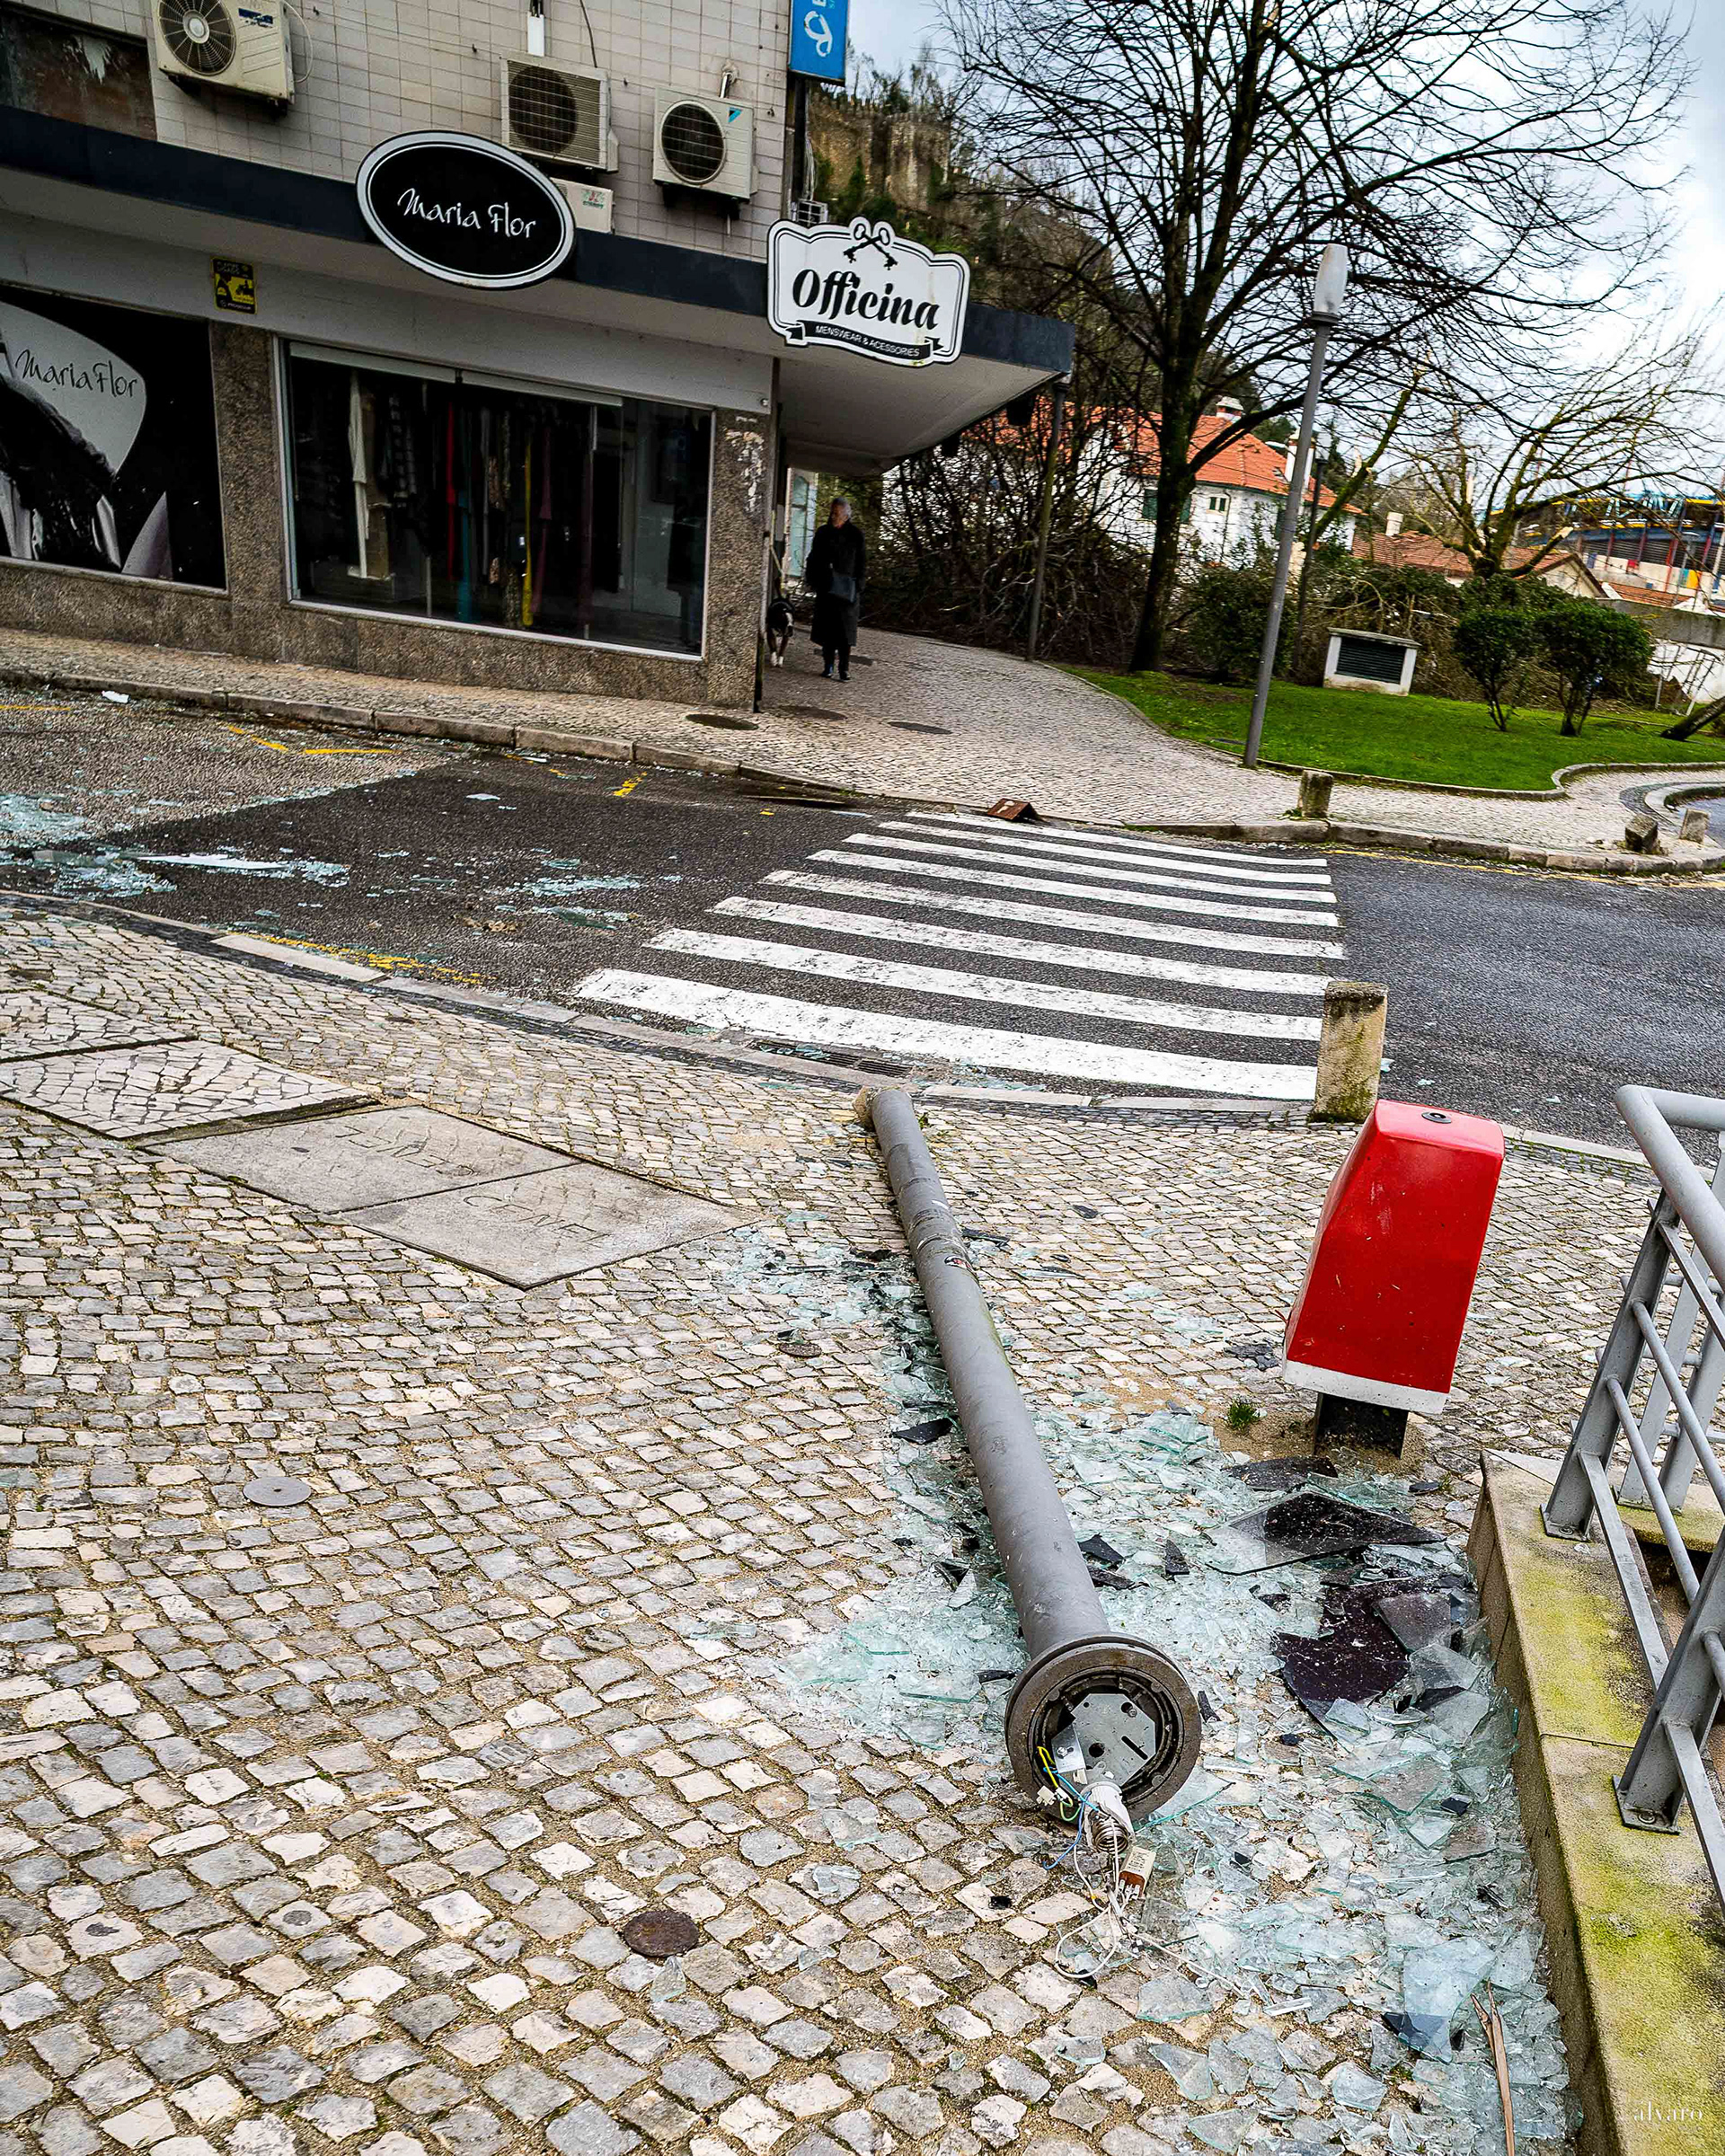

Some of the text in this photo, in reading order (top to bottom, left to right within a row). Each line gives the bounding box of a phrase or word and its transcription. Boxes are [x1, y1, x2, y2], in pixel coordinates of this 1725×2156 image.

[397, 187, 536, 238] Maria Flor
[792, 269, 940, 330] Officina
[815, 325, 862, 342] MENSWEAR
[862, 338, 870, 346] &
[15, 349, 137, 398] Maria Flor
